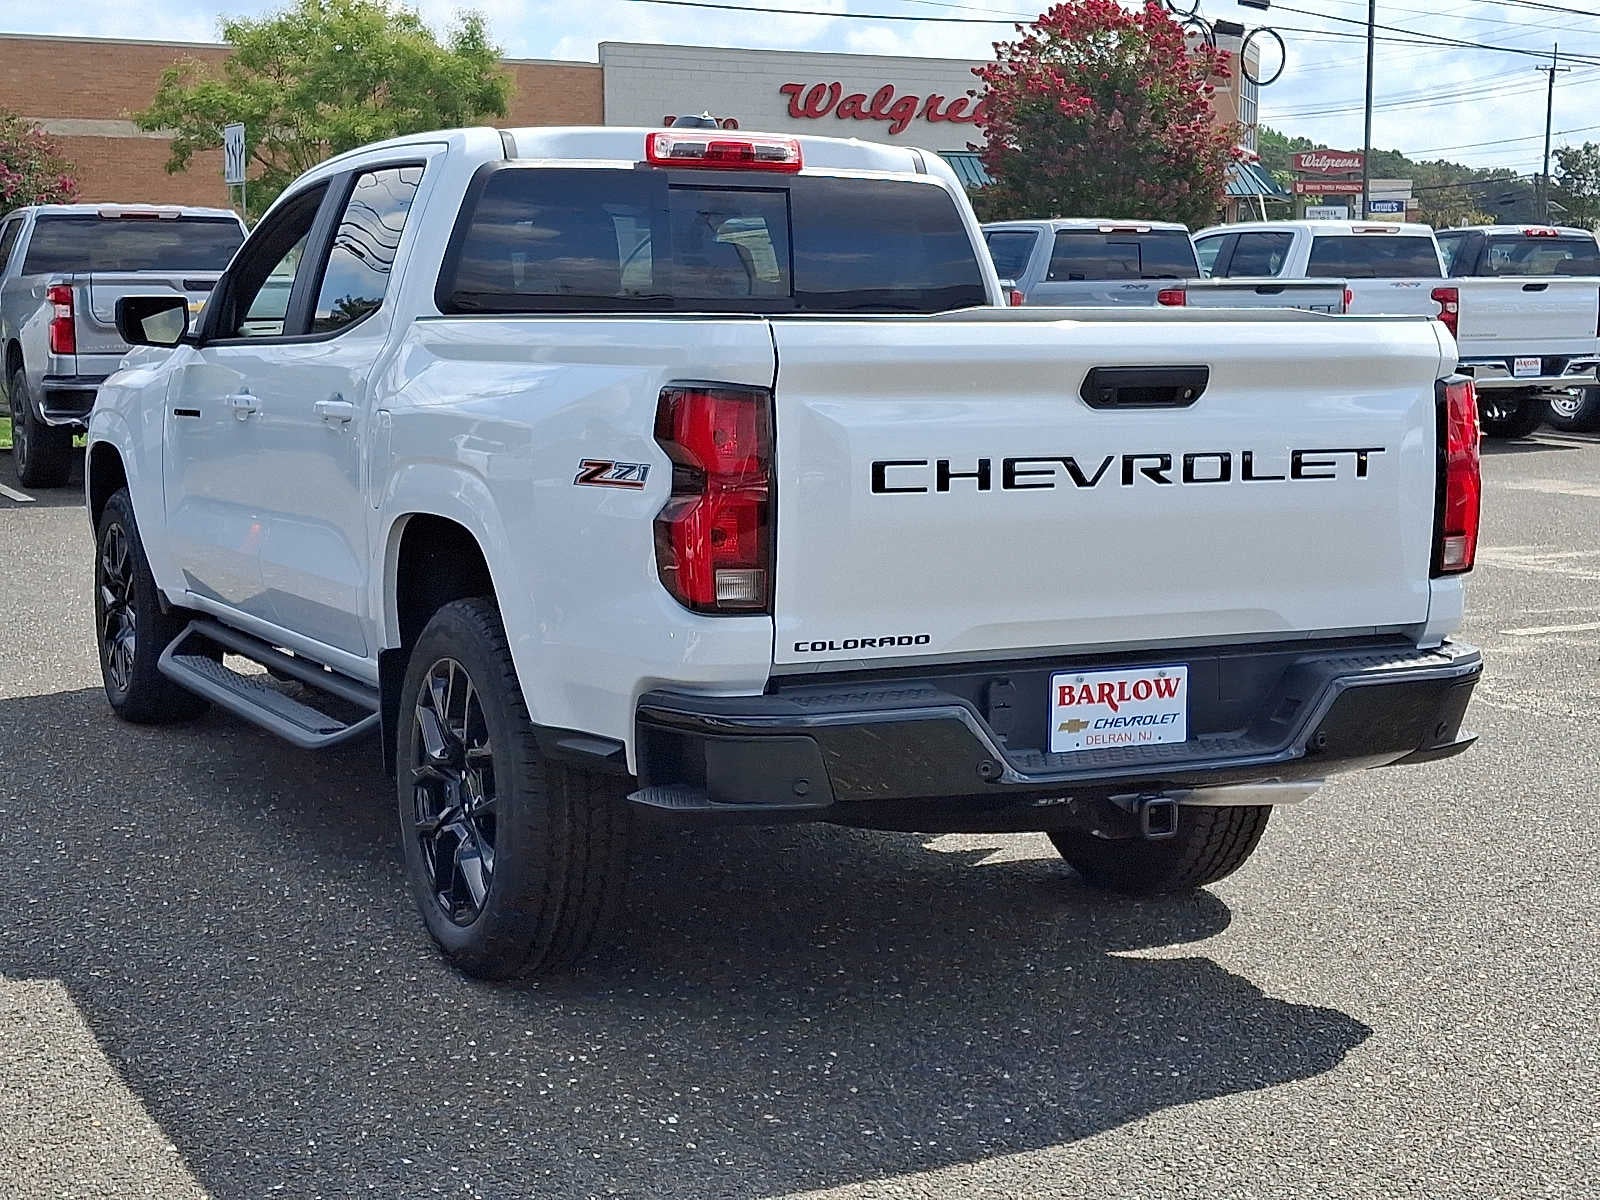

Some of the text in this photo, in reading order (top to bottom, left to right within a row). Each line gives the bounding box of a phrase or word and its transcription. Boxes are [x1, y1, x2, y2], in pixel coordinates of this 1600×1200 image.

[1300, 154, 1360, 171] Walgreens
[573, 458, 651, 491] Z71
[871, 446, 1386, 494] CHEVROLET
[794, 634, 931, 652] COLORADO
[1058, 677, 1181, 713] BARLOW
[1094, 712, 1180, 730] CHEVROLET
[1086, 731, 1152, 746] DELRAN, NJ
